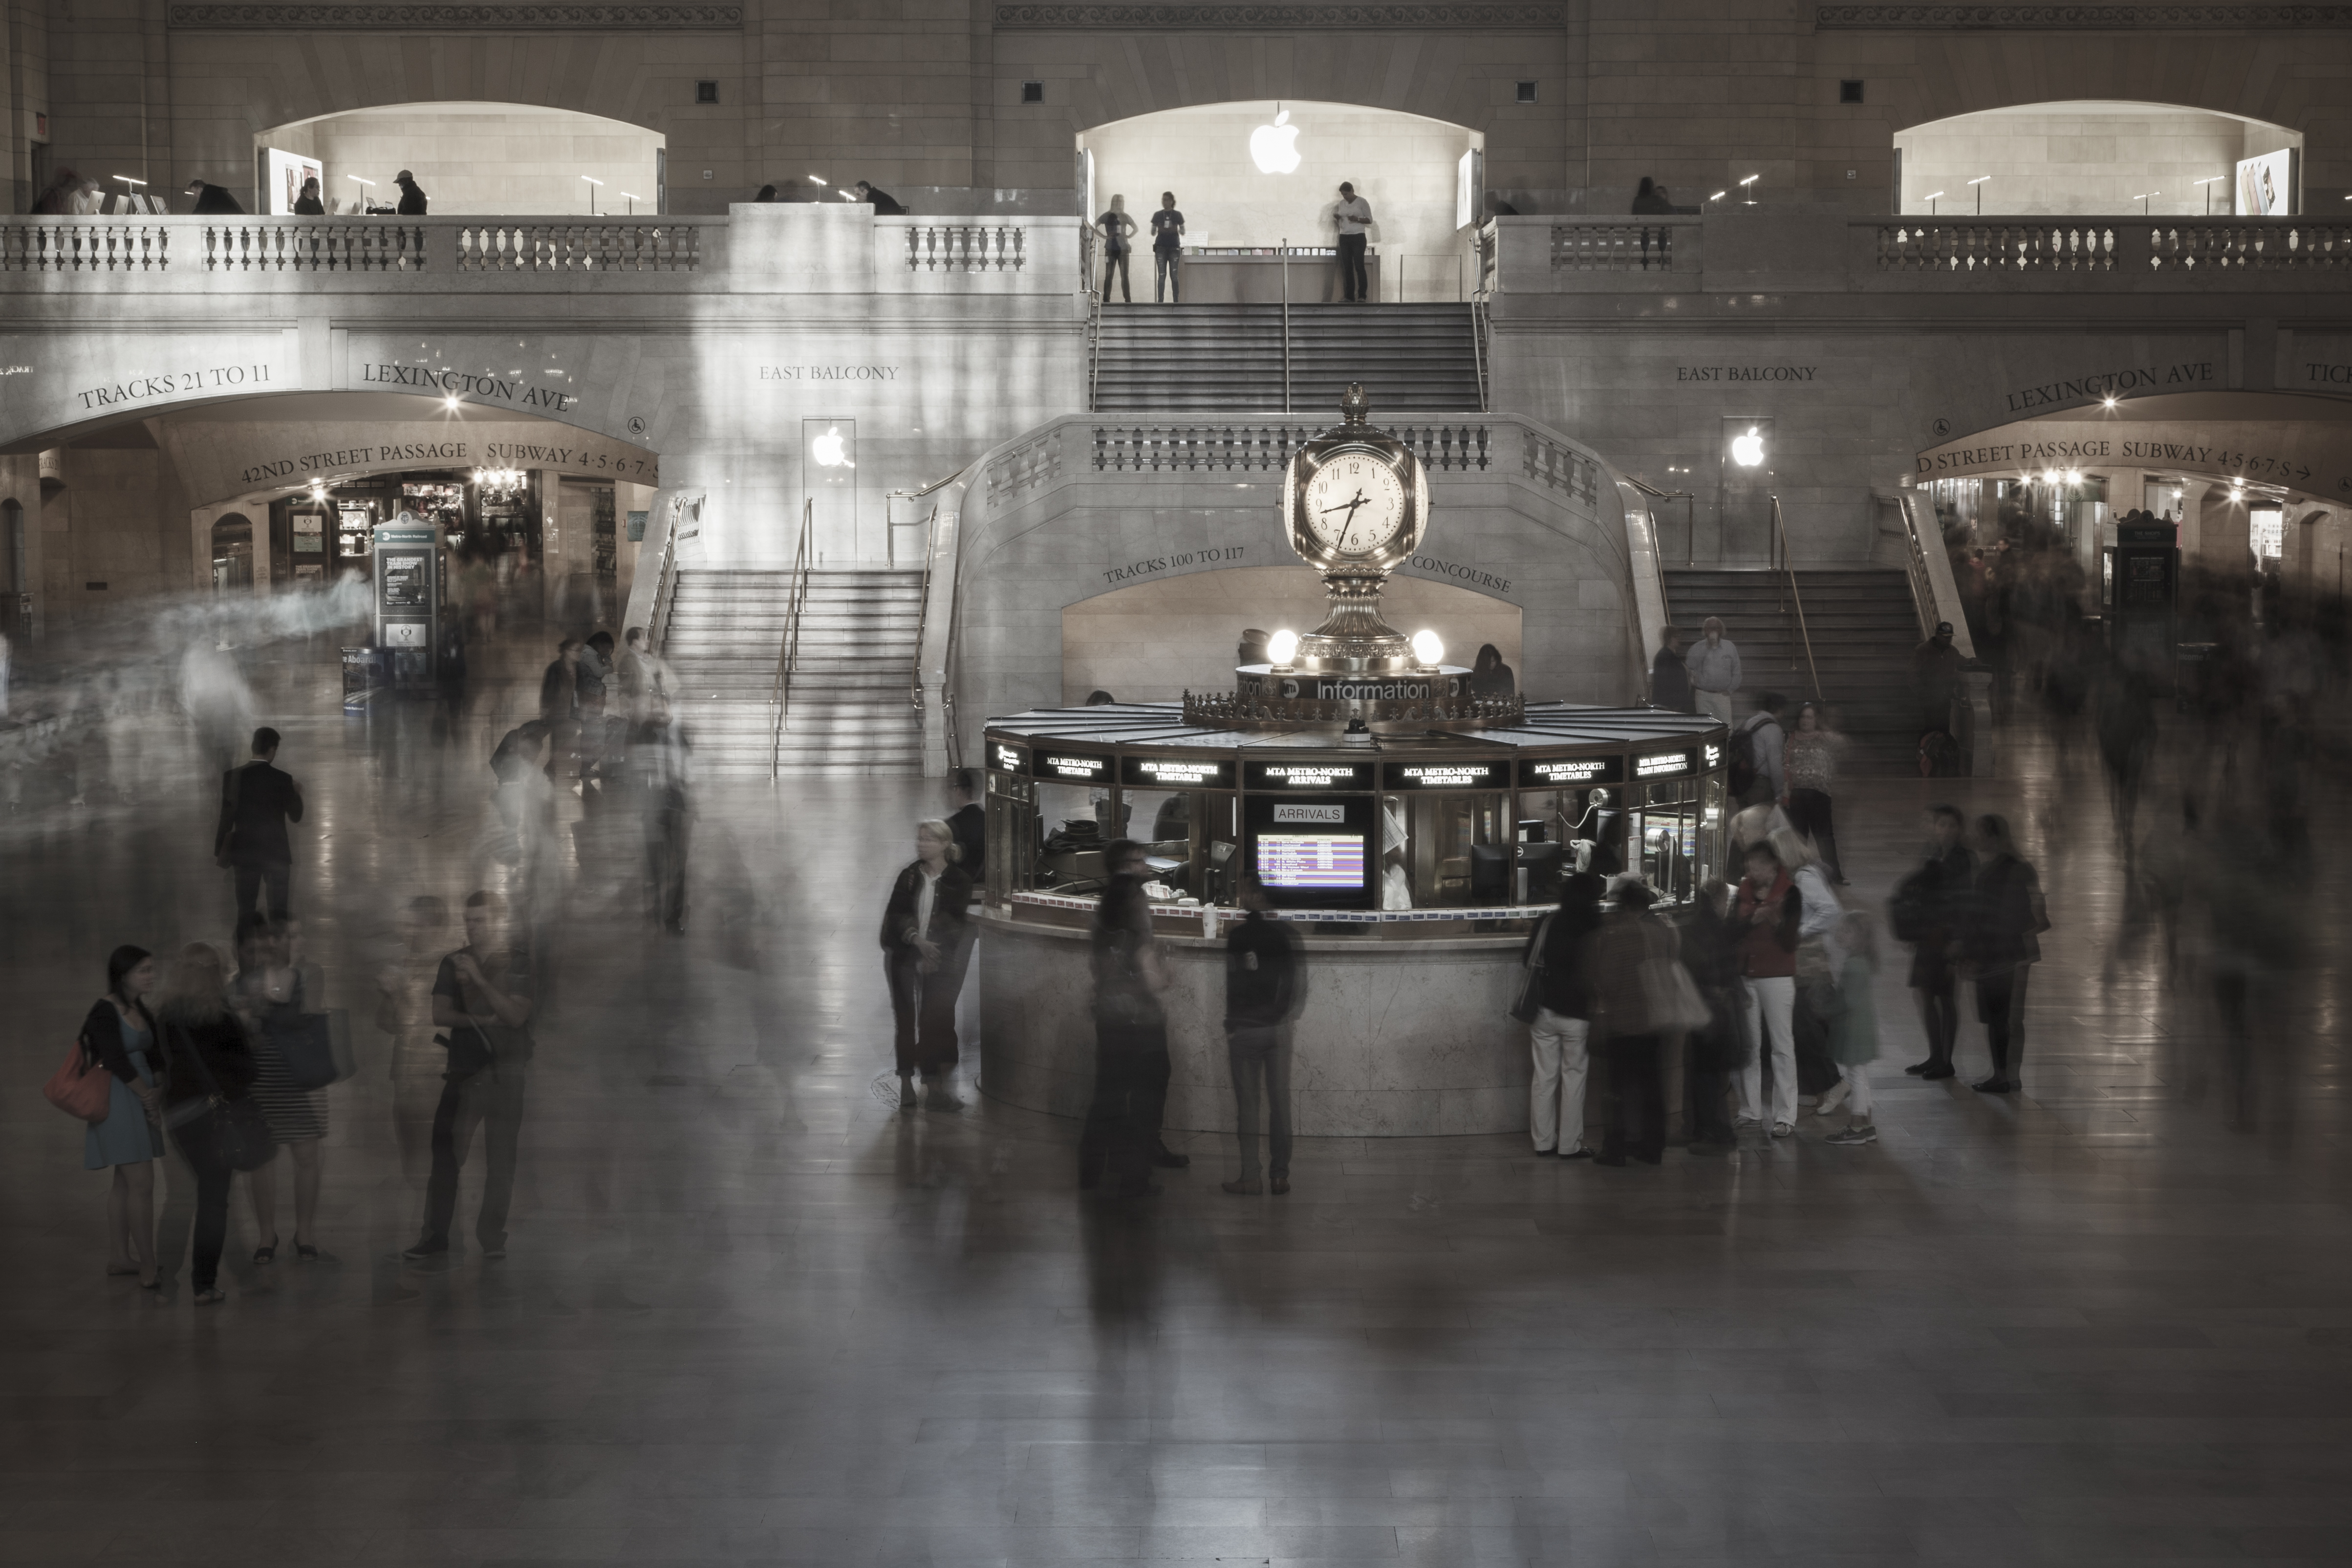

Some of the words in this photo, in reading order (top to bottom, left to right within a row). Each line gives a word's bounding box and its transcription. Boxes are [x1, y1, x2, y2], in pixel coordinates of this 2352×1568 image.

[761, 366, 800, 379] EAST
[812, 366, 893, 379] BALCONY
[1677, 367, 1722, 380] EAST
[1728, 367, 1817, 380] BALCONY
[78, 374, 175, 409] TRACKS
[183, 372, 201, 389] 21
[210, 367, 243, 385] TO
[254, 365, 268, 381] 11
[363, 364, 516, 400] LEXINGTON
[521, 387, 569, 411] AVE
[2006, 367, 2157, 411] LEXINGTON
[2166, 363, 2212, 383] AVE
[1937, 445, 2014, 471] STREET
[2021, 441, 2109, 458] PASSAGE
[2123, 442, 2212, 462] SUBWAY
[242, 461, 294, 483] 42ND
[300, 448, 372, 471] STREET
[380, 443, 466, 460] PASSAGE
[488, 444, 572, 463] SUBWAY
[1349, 462, 1359, 474] 12
[1103, 558, 1166, 583] TRACKS
[1171, 554, 1192, 567] 100
[1197, 549, 1220, 562] TO
[1226, 547, 1243, 559] 117
[1411, 557, 1511, 594] CONCOURSE
[1318, 680, 1431, 700] Information
[1046, 757, 1059, 767] MTA
[1060, 758, 1103, 770] METRO-NORTH
[1639, 759, 1651, 767] MTA
[1651, 754, 1686, 766] METRO-NORTH
[1057, 766, 1093, 777] TIMETABLES
[1140, 762, 1159, 773] MTA
[1159, 763, 1218, 776] METRO-NORTH
[1266, 767, 1286, 777] MTA
[1287, 767, 1354, 777] METRO-NORTH
[1403, 768, 1424, 777] MTA
[1424, 767, 1489, 777] METRO-NORTH
[1534, 764, 1552, 774] MTA
[1551, 762, 1606, 773] METRO-NORTH
[1637, 766, 1654, 775] TRAIN
[1653, 762, 1688, 773] INFORMATION
[1155, 771, 1204, 783] TIMETABLES
[1287, 775, 1332, 785] ARRIVALS
[1420, 775, 1473, 784] TIMETABLES
[1549, 771, 1592, 781] TIMETABLES
[1279, 809, 1339, 819] ARRIVALS
